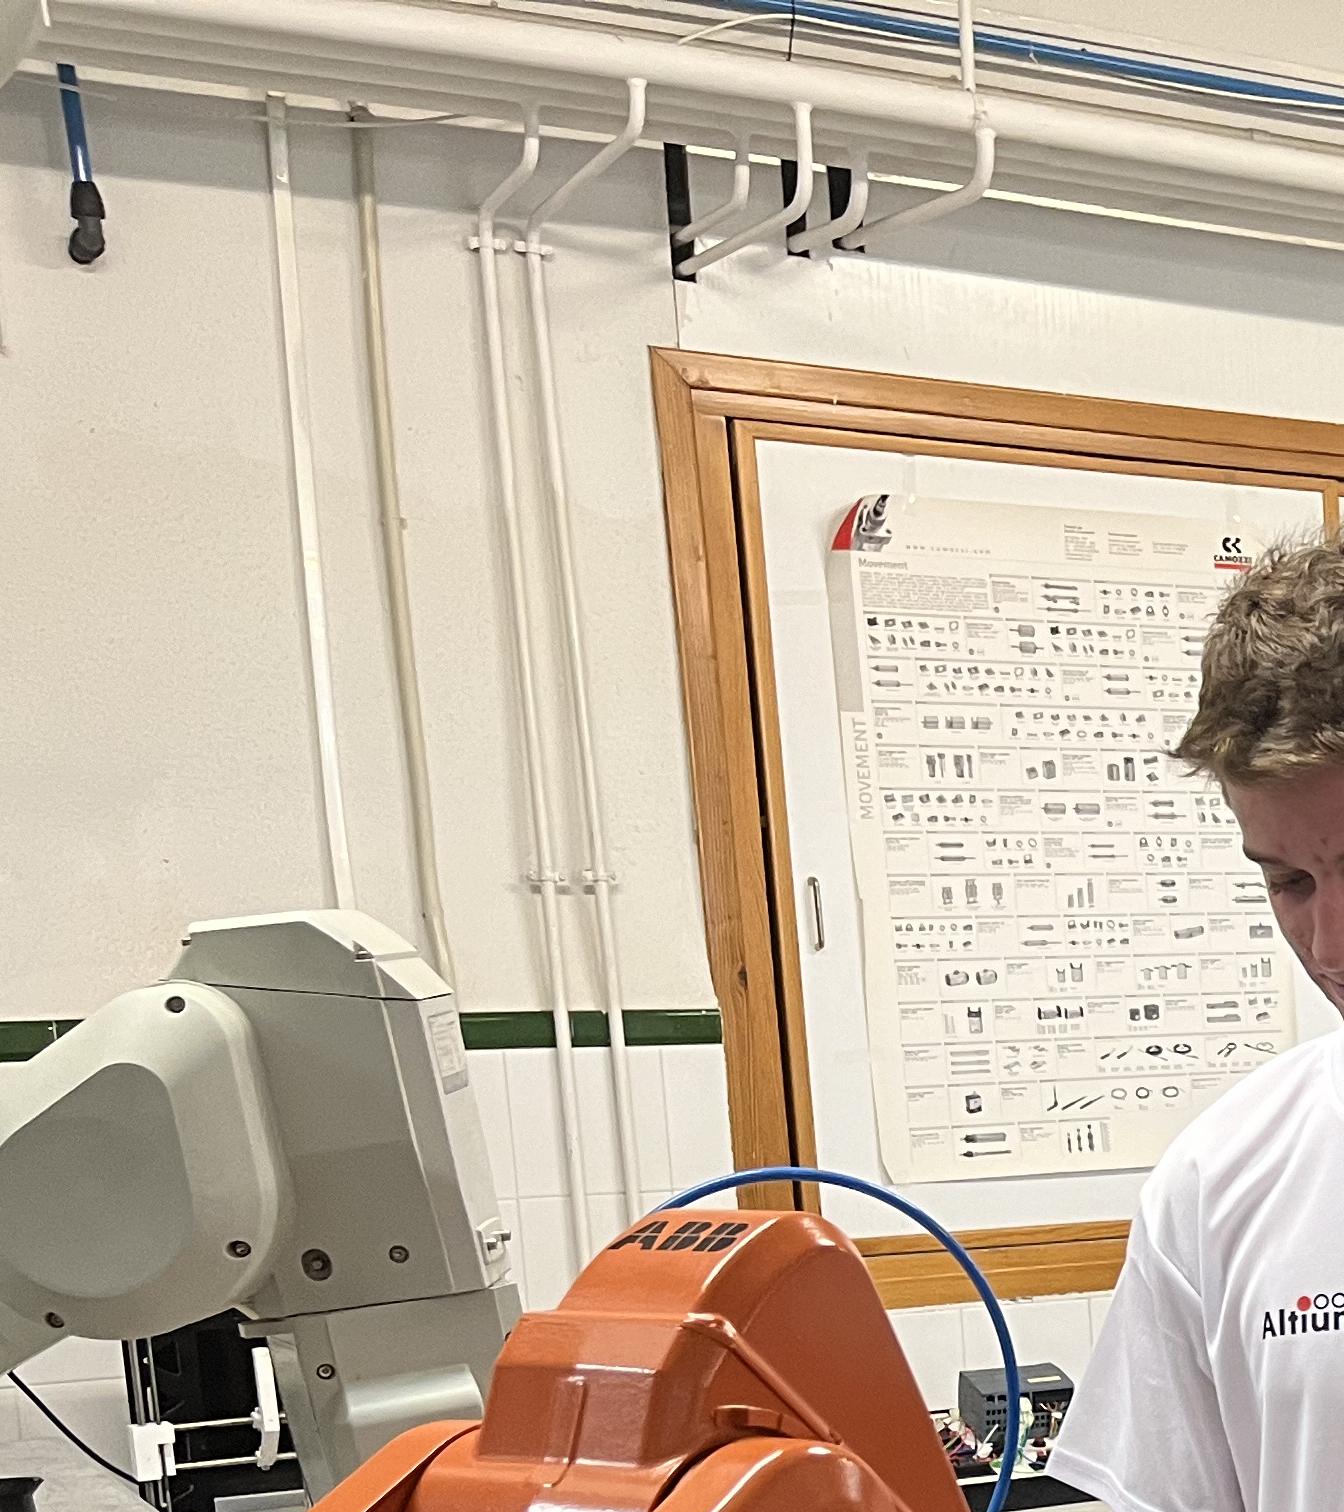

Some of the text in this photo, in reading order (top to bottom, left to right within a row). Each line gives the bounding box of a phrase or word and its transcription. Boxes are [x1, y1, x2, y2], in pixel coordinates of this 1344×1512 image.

[858, 557, 908, 570] Movement
[851, 717, 874, 820] MOVEMENT
[607, 1221, 749, 1252] ABB
